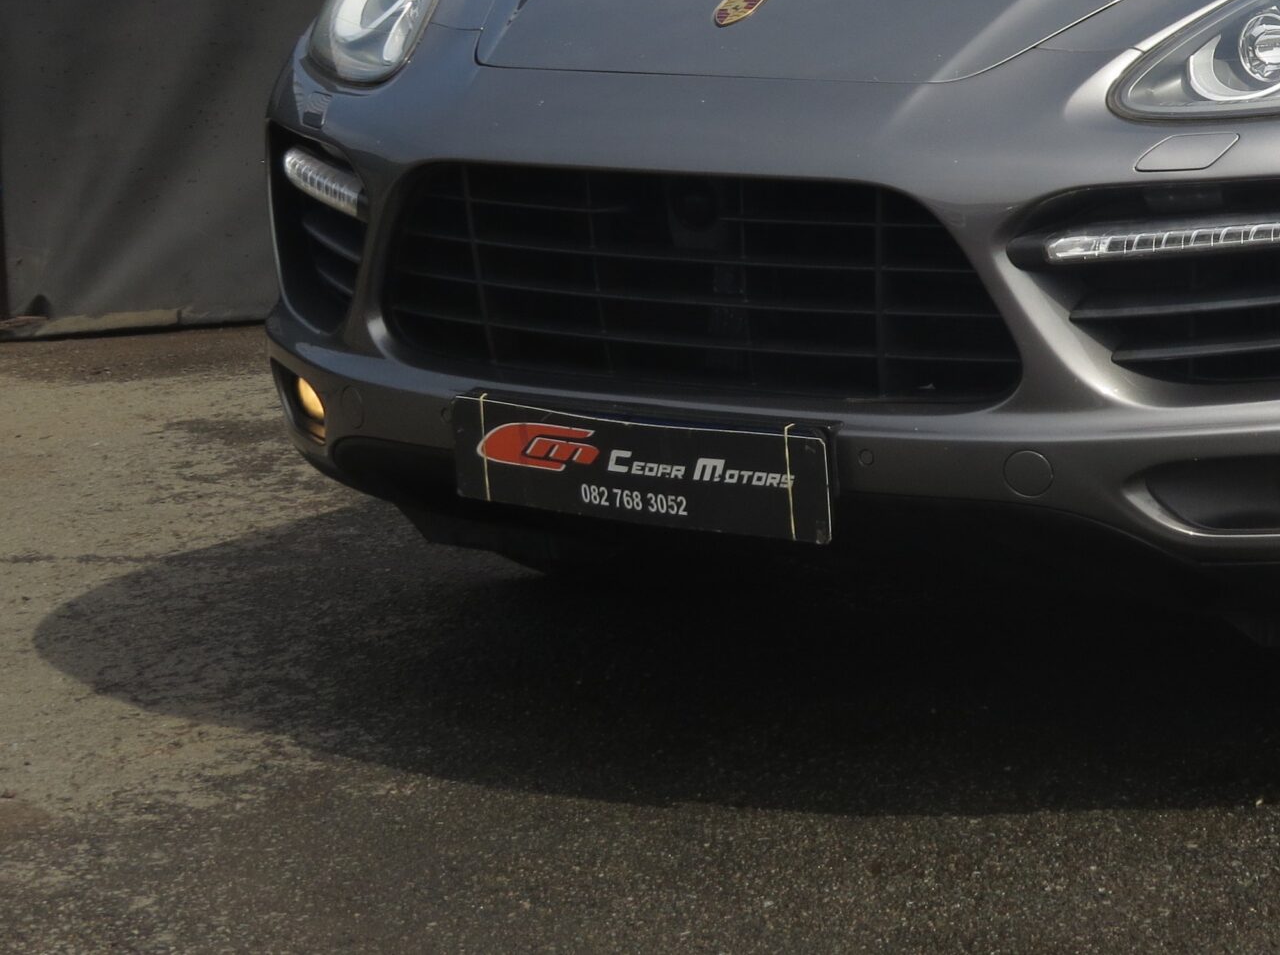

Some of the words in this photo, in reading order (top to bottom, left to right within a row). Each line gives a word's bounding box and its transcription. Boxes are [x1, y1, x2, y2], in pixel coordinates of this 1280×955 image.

[580, 483, 610, 507] 082
[614, 488, 643, 512] 768
[647, 493, 688, 517] 3052
